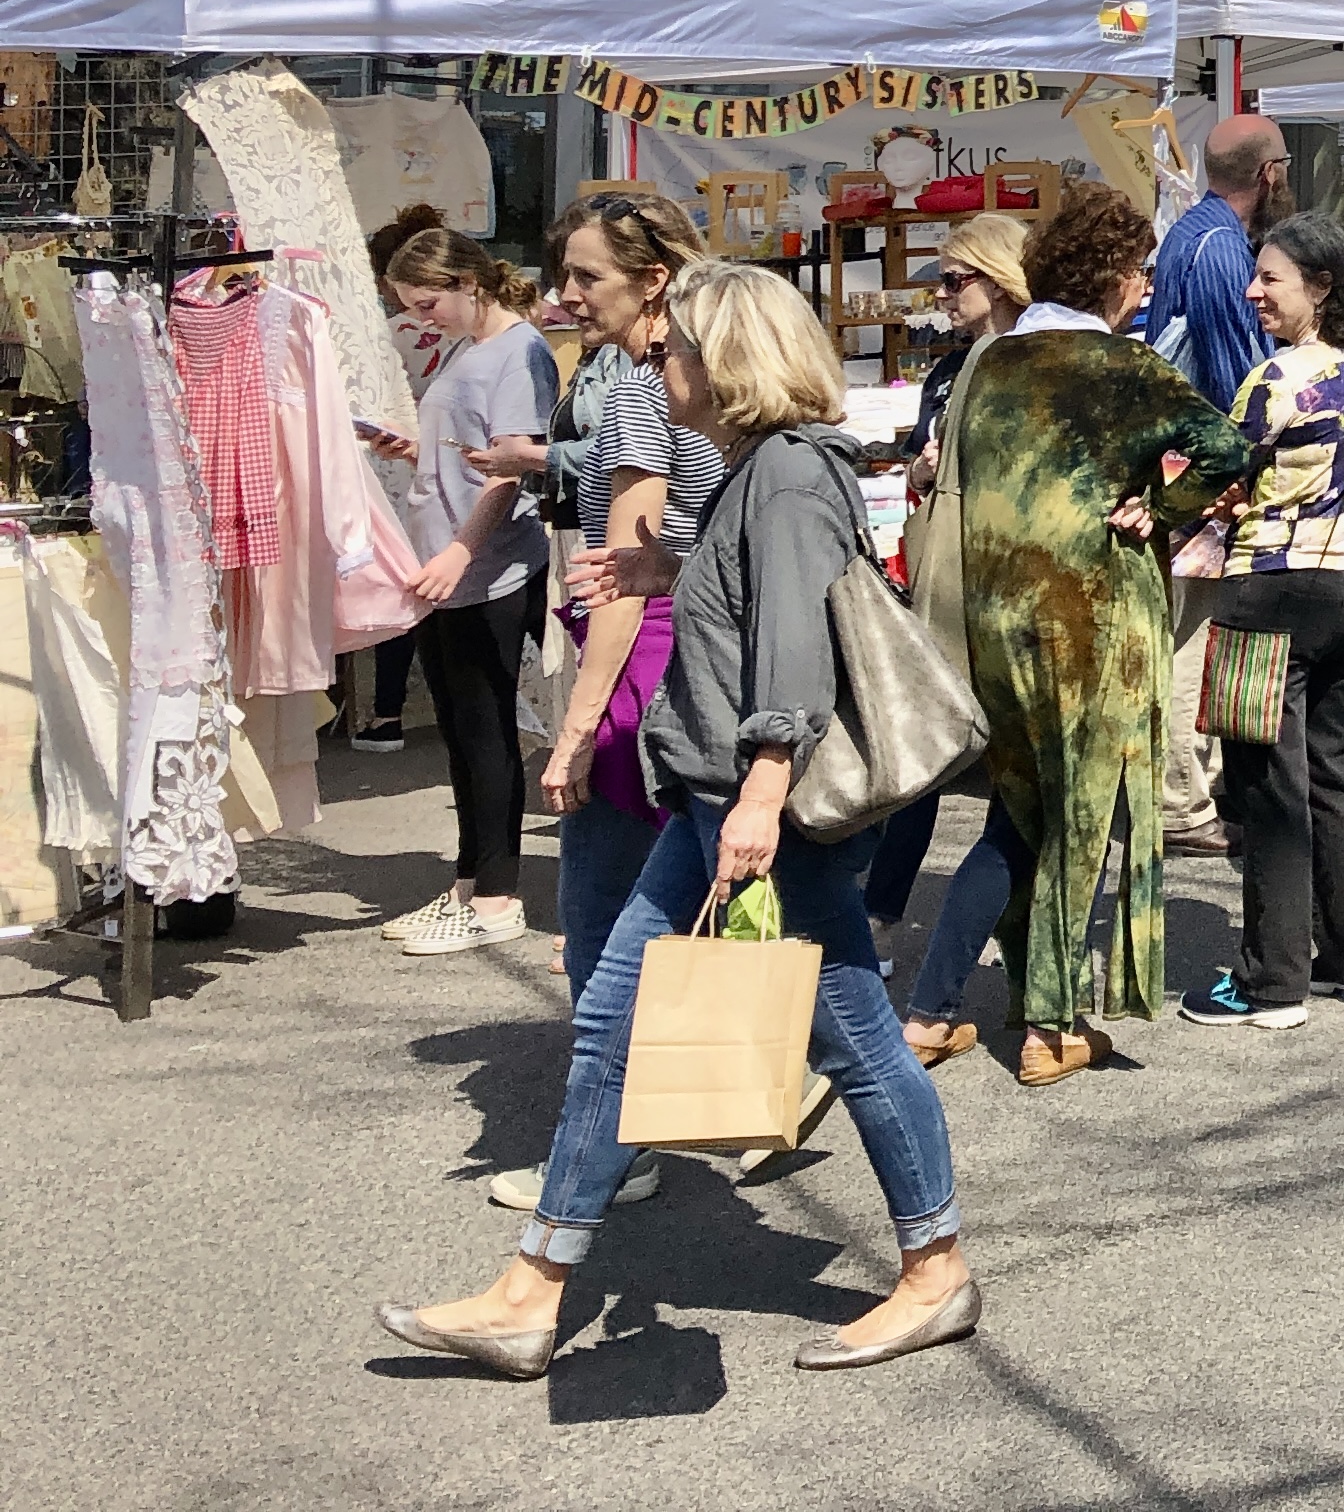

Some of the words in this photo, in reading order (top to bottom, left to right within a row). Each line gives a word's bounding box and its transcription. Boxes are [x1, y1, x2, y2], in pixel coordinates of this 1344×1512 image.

[481, 53, 563, 93] THE
[576, 61, 862, 138] MID-CENTURY
[879, 69, 1037, 112] SISTERS
